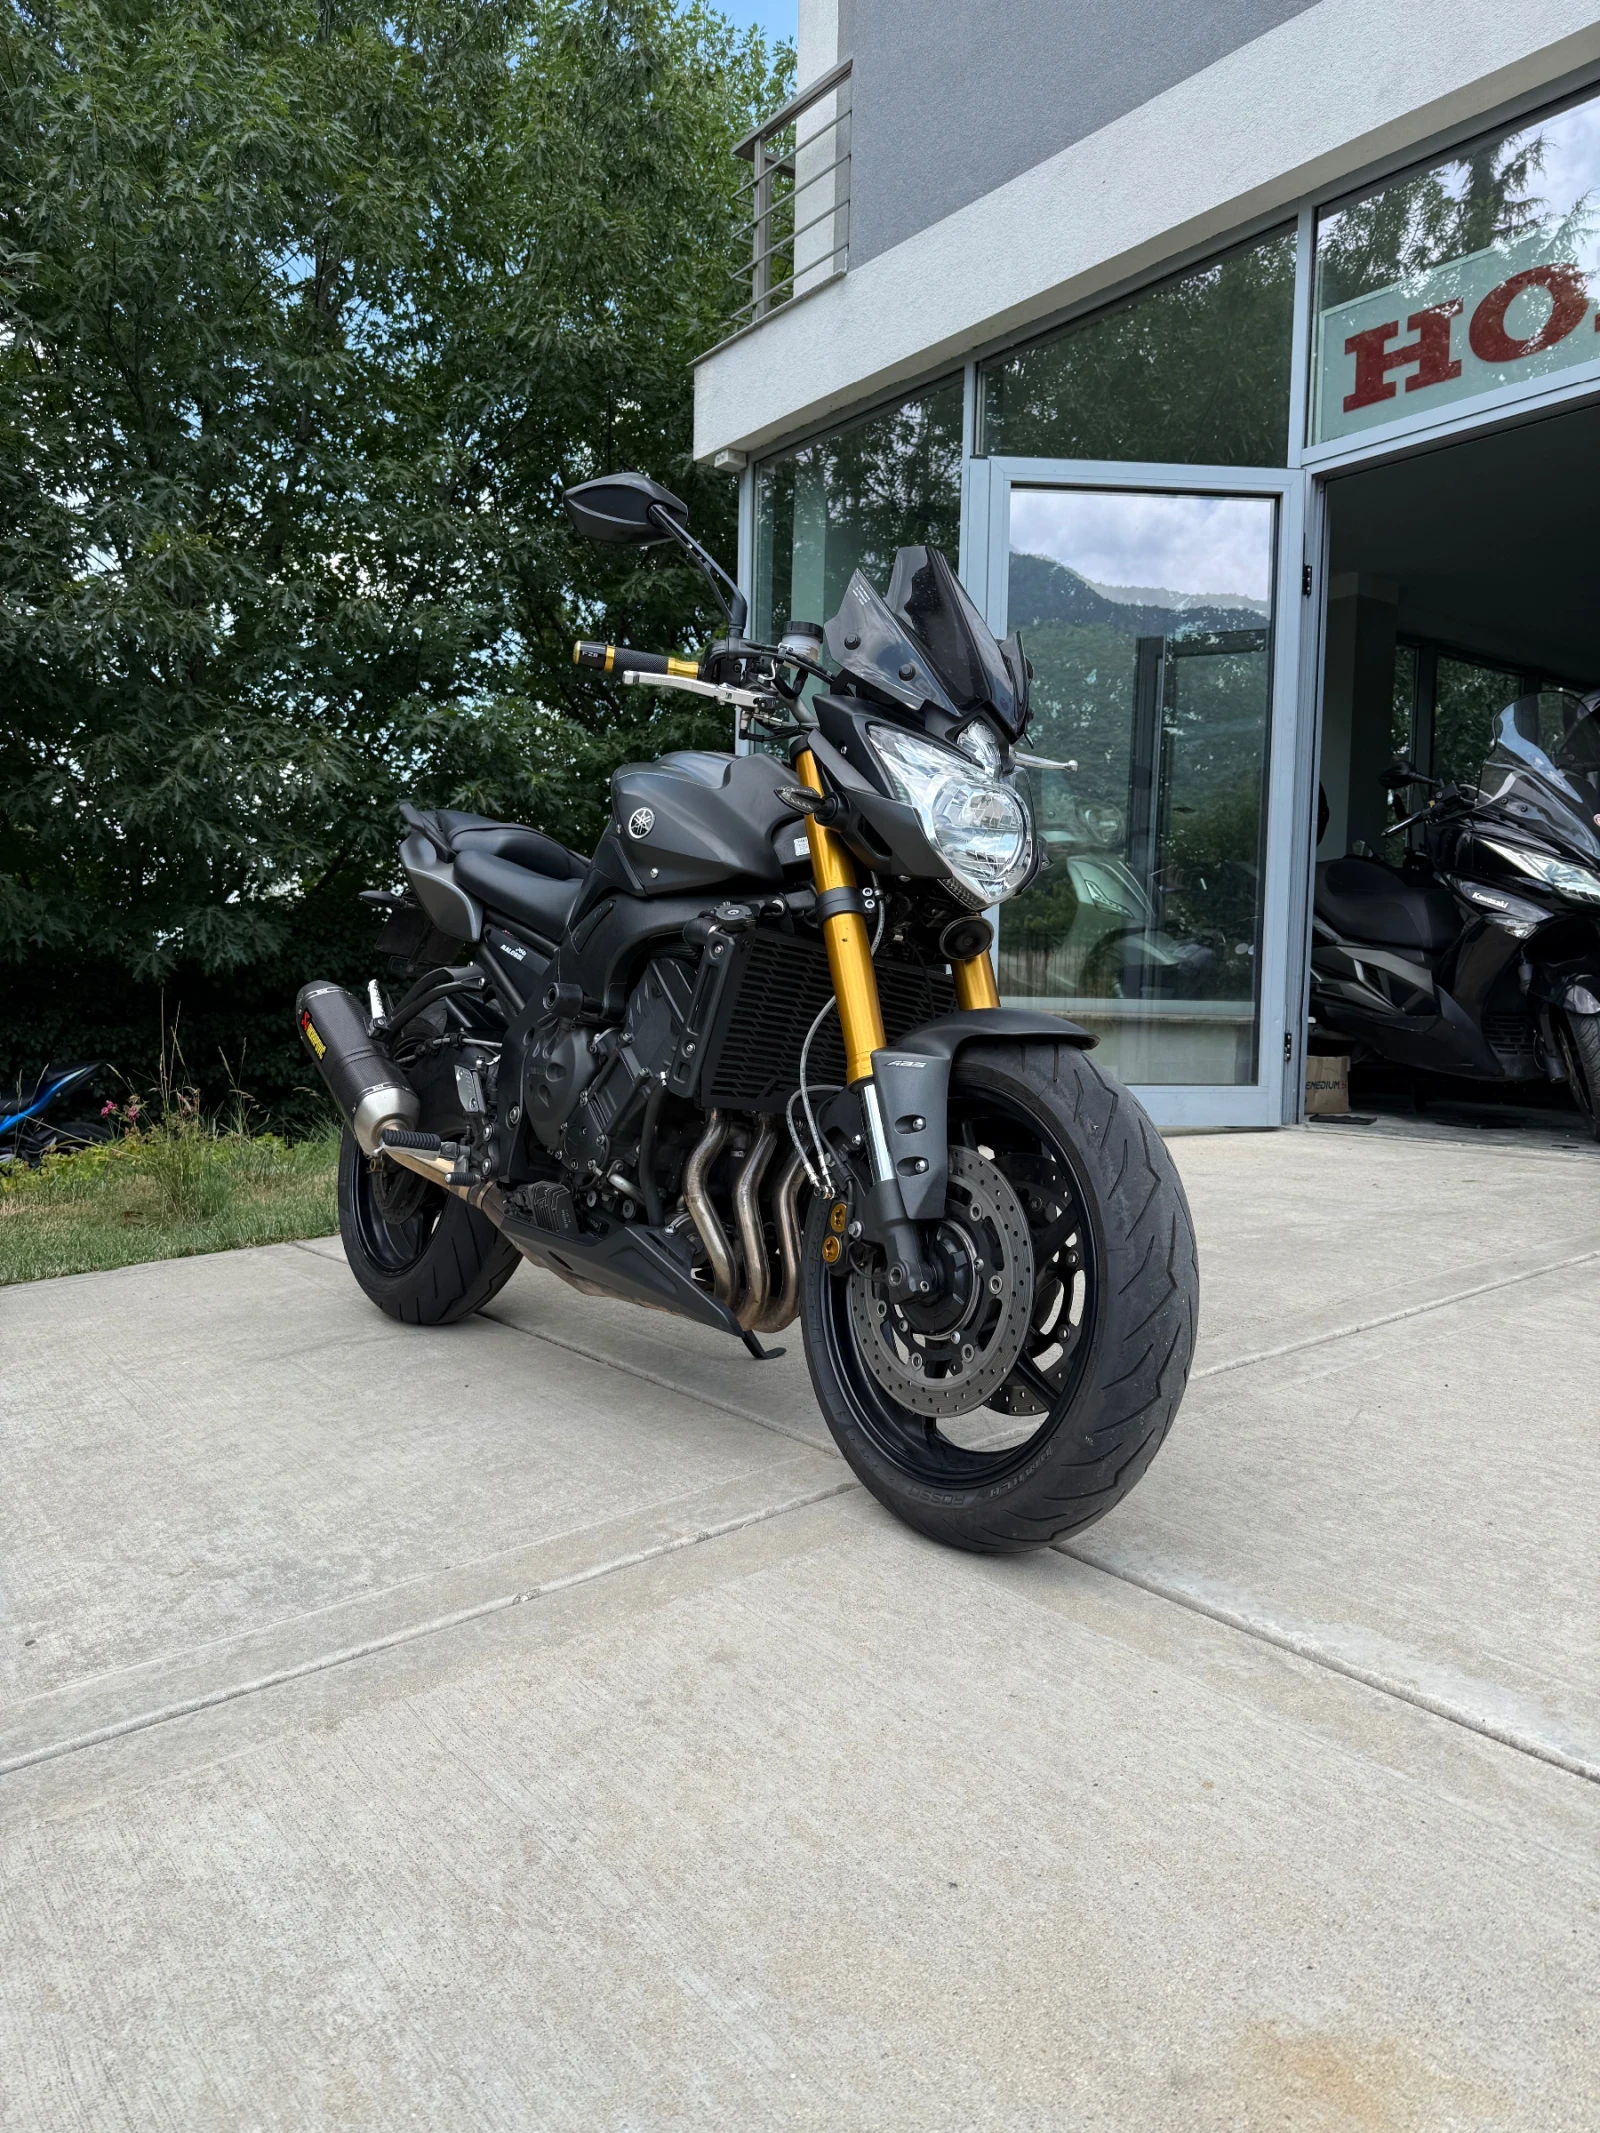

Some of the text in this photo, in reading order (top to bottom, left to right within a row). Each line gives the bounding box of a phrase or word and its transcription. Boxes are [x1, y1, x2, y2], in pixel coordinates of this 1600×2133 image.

[1343, 262, 1600, 413] HO
[1471, 891, 1509, 909] Kawasaki
[887, 1060, 928, 1068] ABS
[908, 1487, 966, 1506] ROSSO
